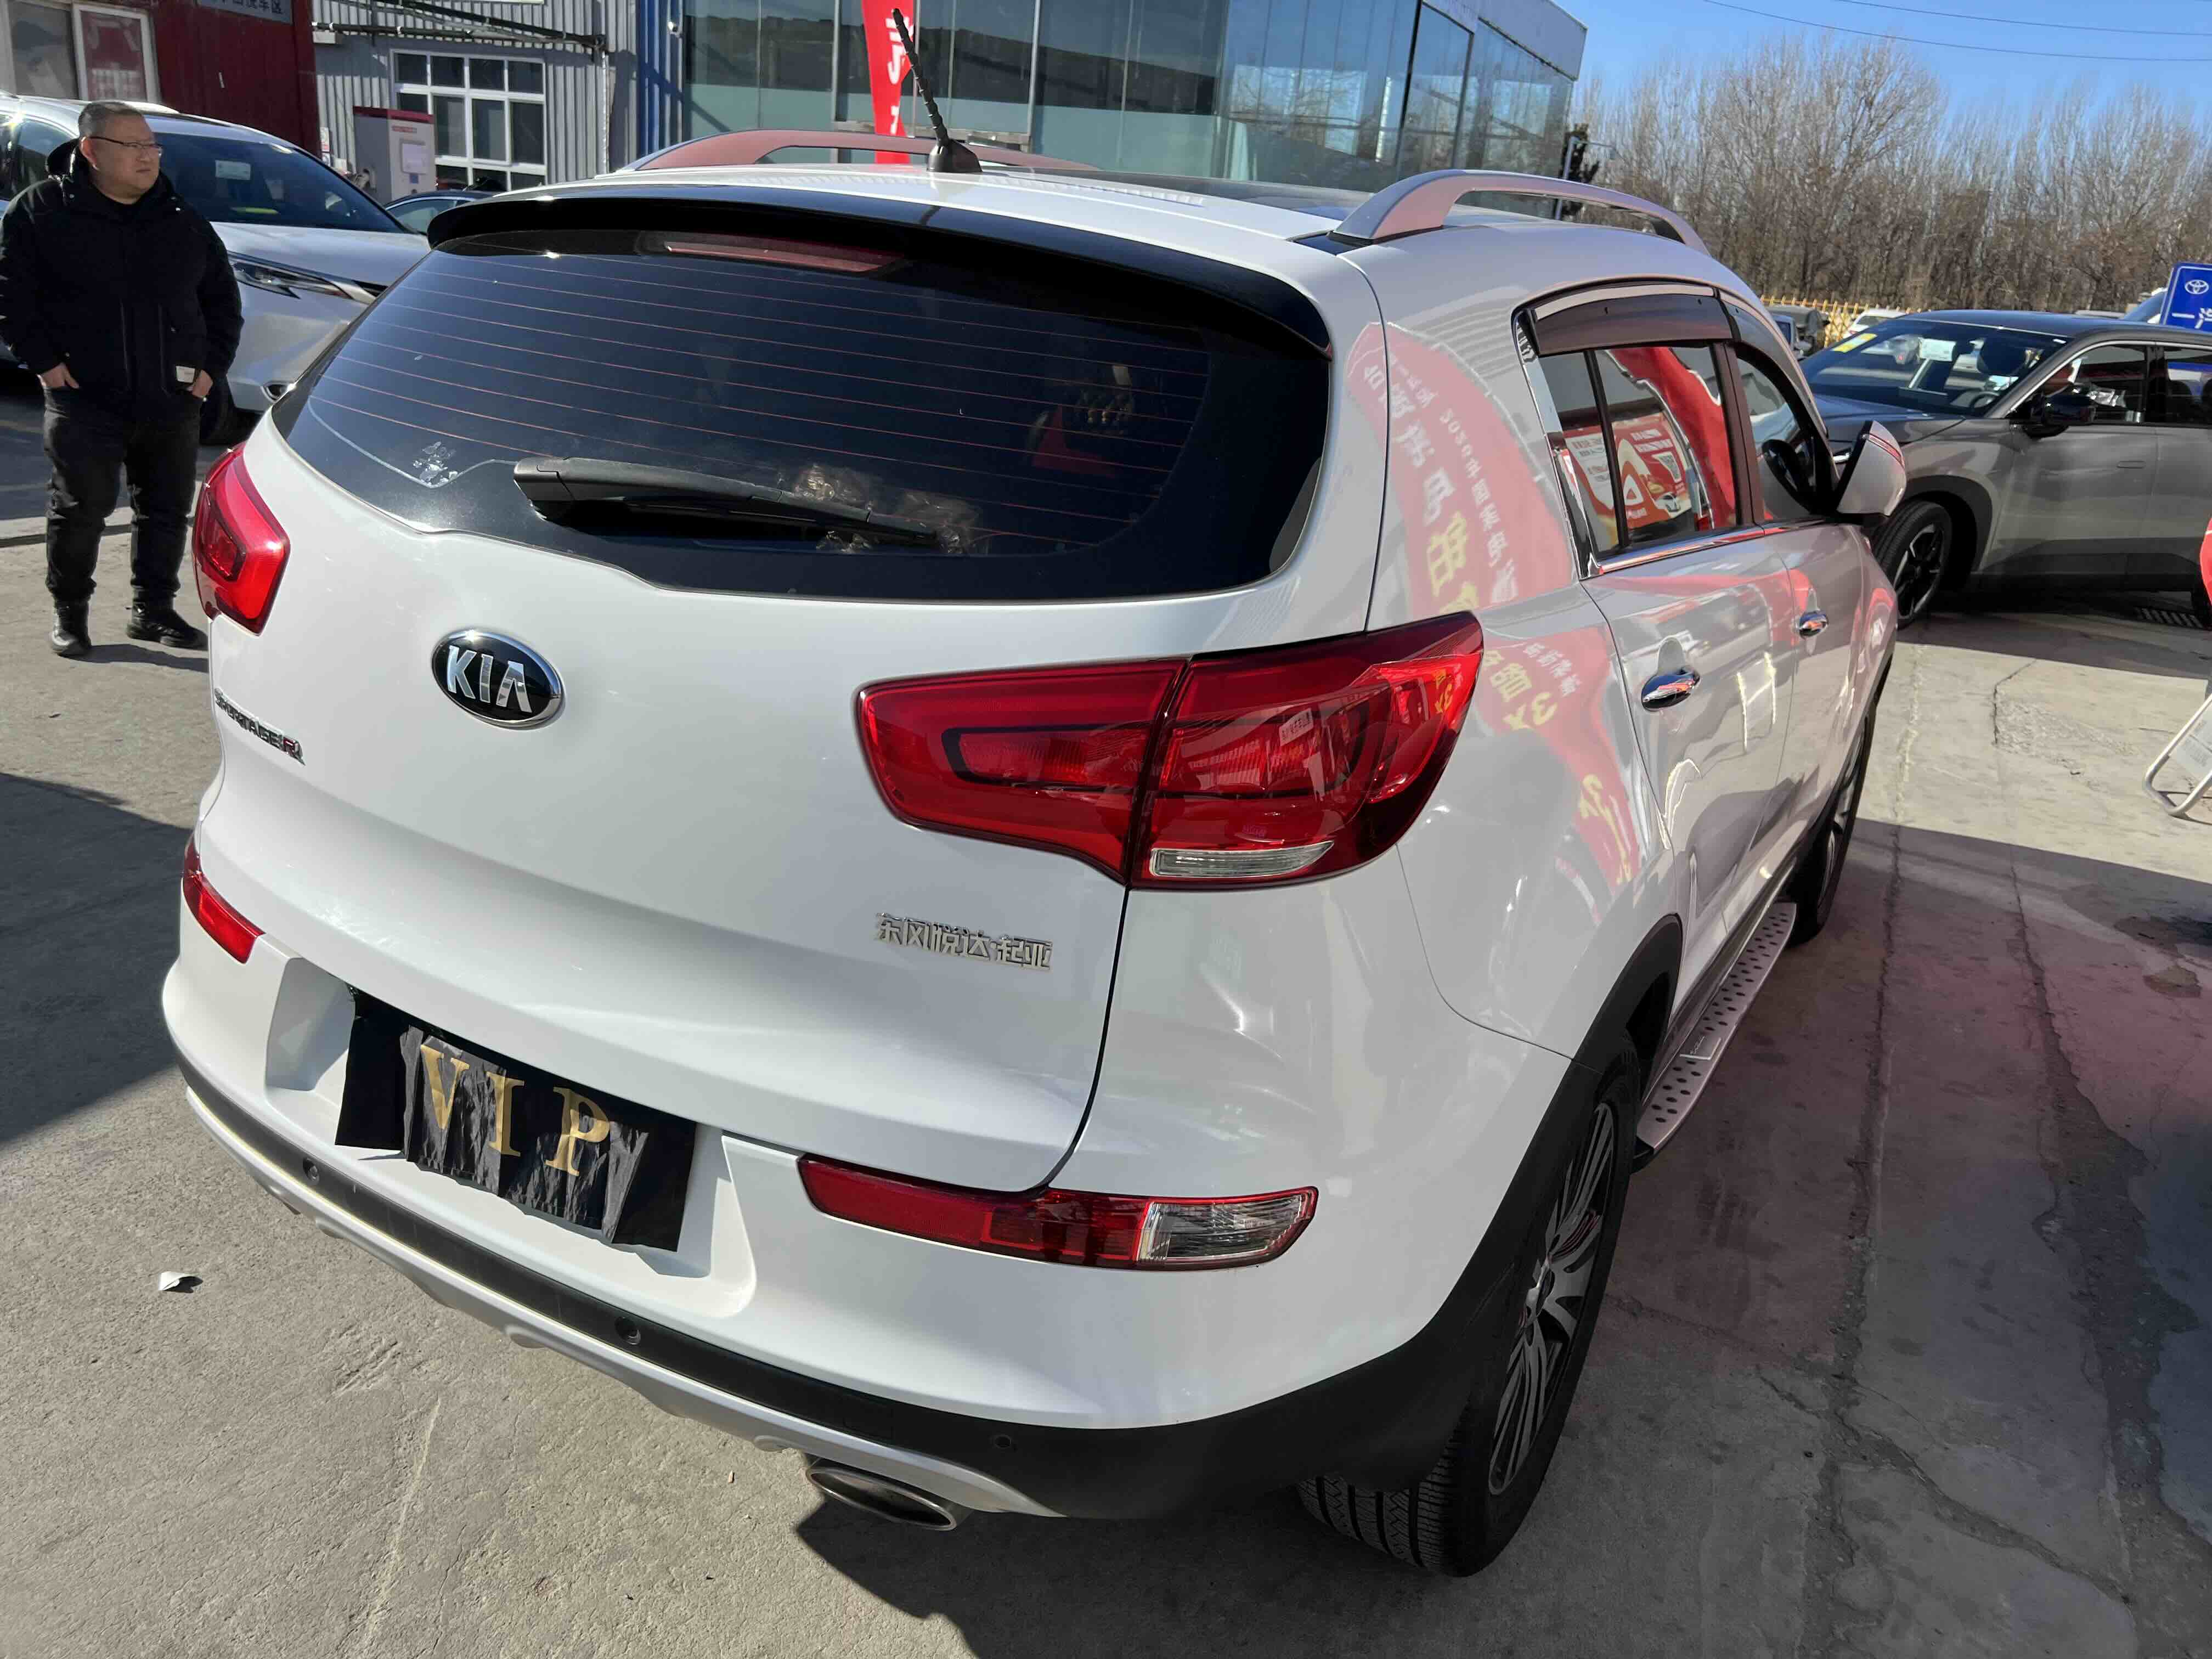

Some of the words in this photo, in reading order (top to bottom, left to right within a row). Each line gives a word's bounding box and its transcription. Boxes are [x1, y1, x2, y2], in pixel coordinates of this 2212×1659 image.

[447, 645, 532, 713] KIA
[874, 912, 1053, 972] 东风悦达起亚
[420, 1044, 611, 1177] VIP
